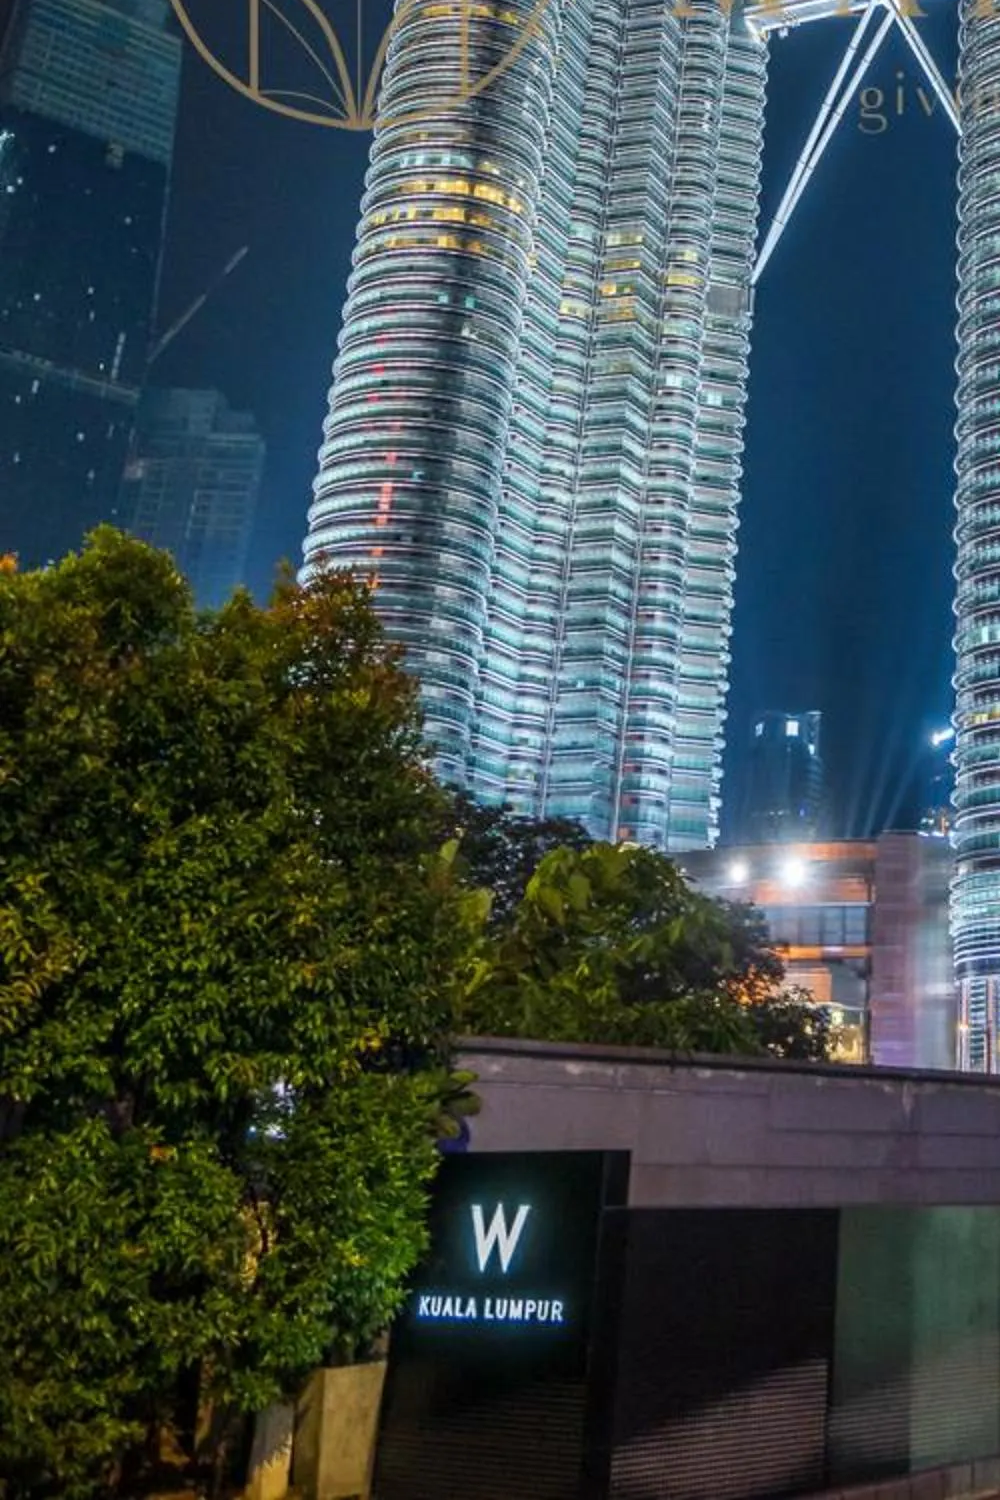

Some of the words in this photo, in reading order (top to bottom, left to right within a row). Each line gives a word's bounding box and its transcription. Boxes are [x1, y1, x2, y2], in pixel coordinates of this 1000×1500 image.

[471, 1203, 531, 1274] W
[418, 1296, 477, 1318] KUALA
[484, 1298, 564, 1322] LUMPUR
